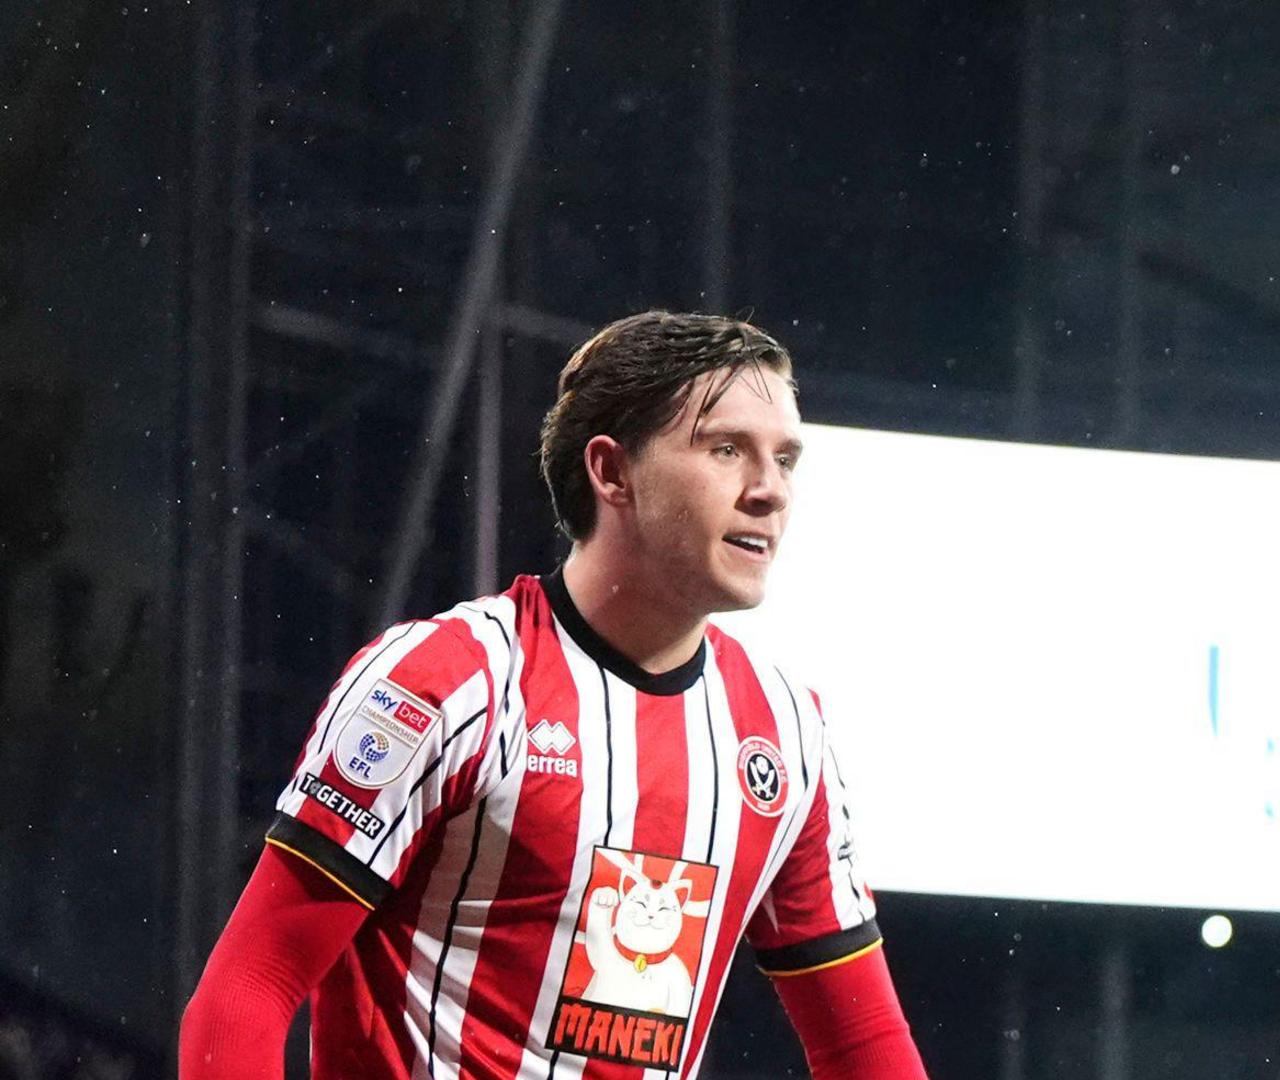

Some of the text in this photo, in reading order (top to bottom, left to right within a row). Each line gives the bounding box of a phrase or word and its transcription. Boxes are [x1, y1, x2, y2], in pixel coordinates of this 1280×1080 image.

[371, 688, 427, 728] sky bet
[349, 756, 373, 780] EFL
[527, 754, 578, 778] errea
[554, 1003, 684, 1066] MANEKI
